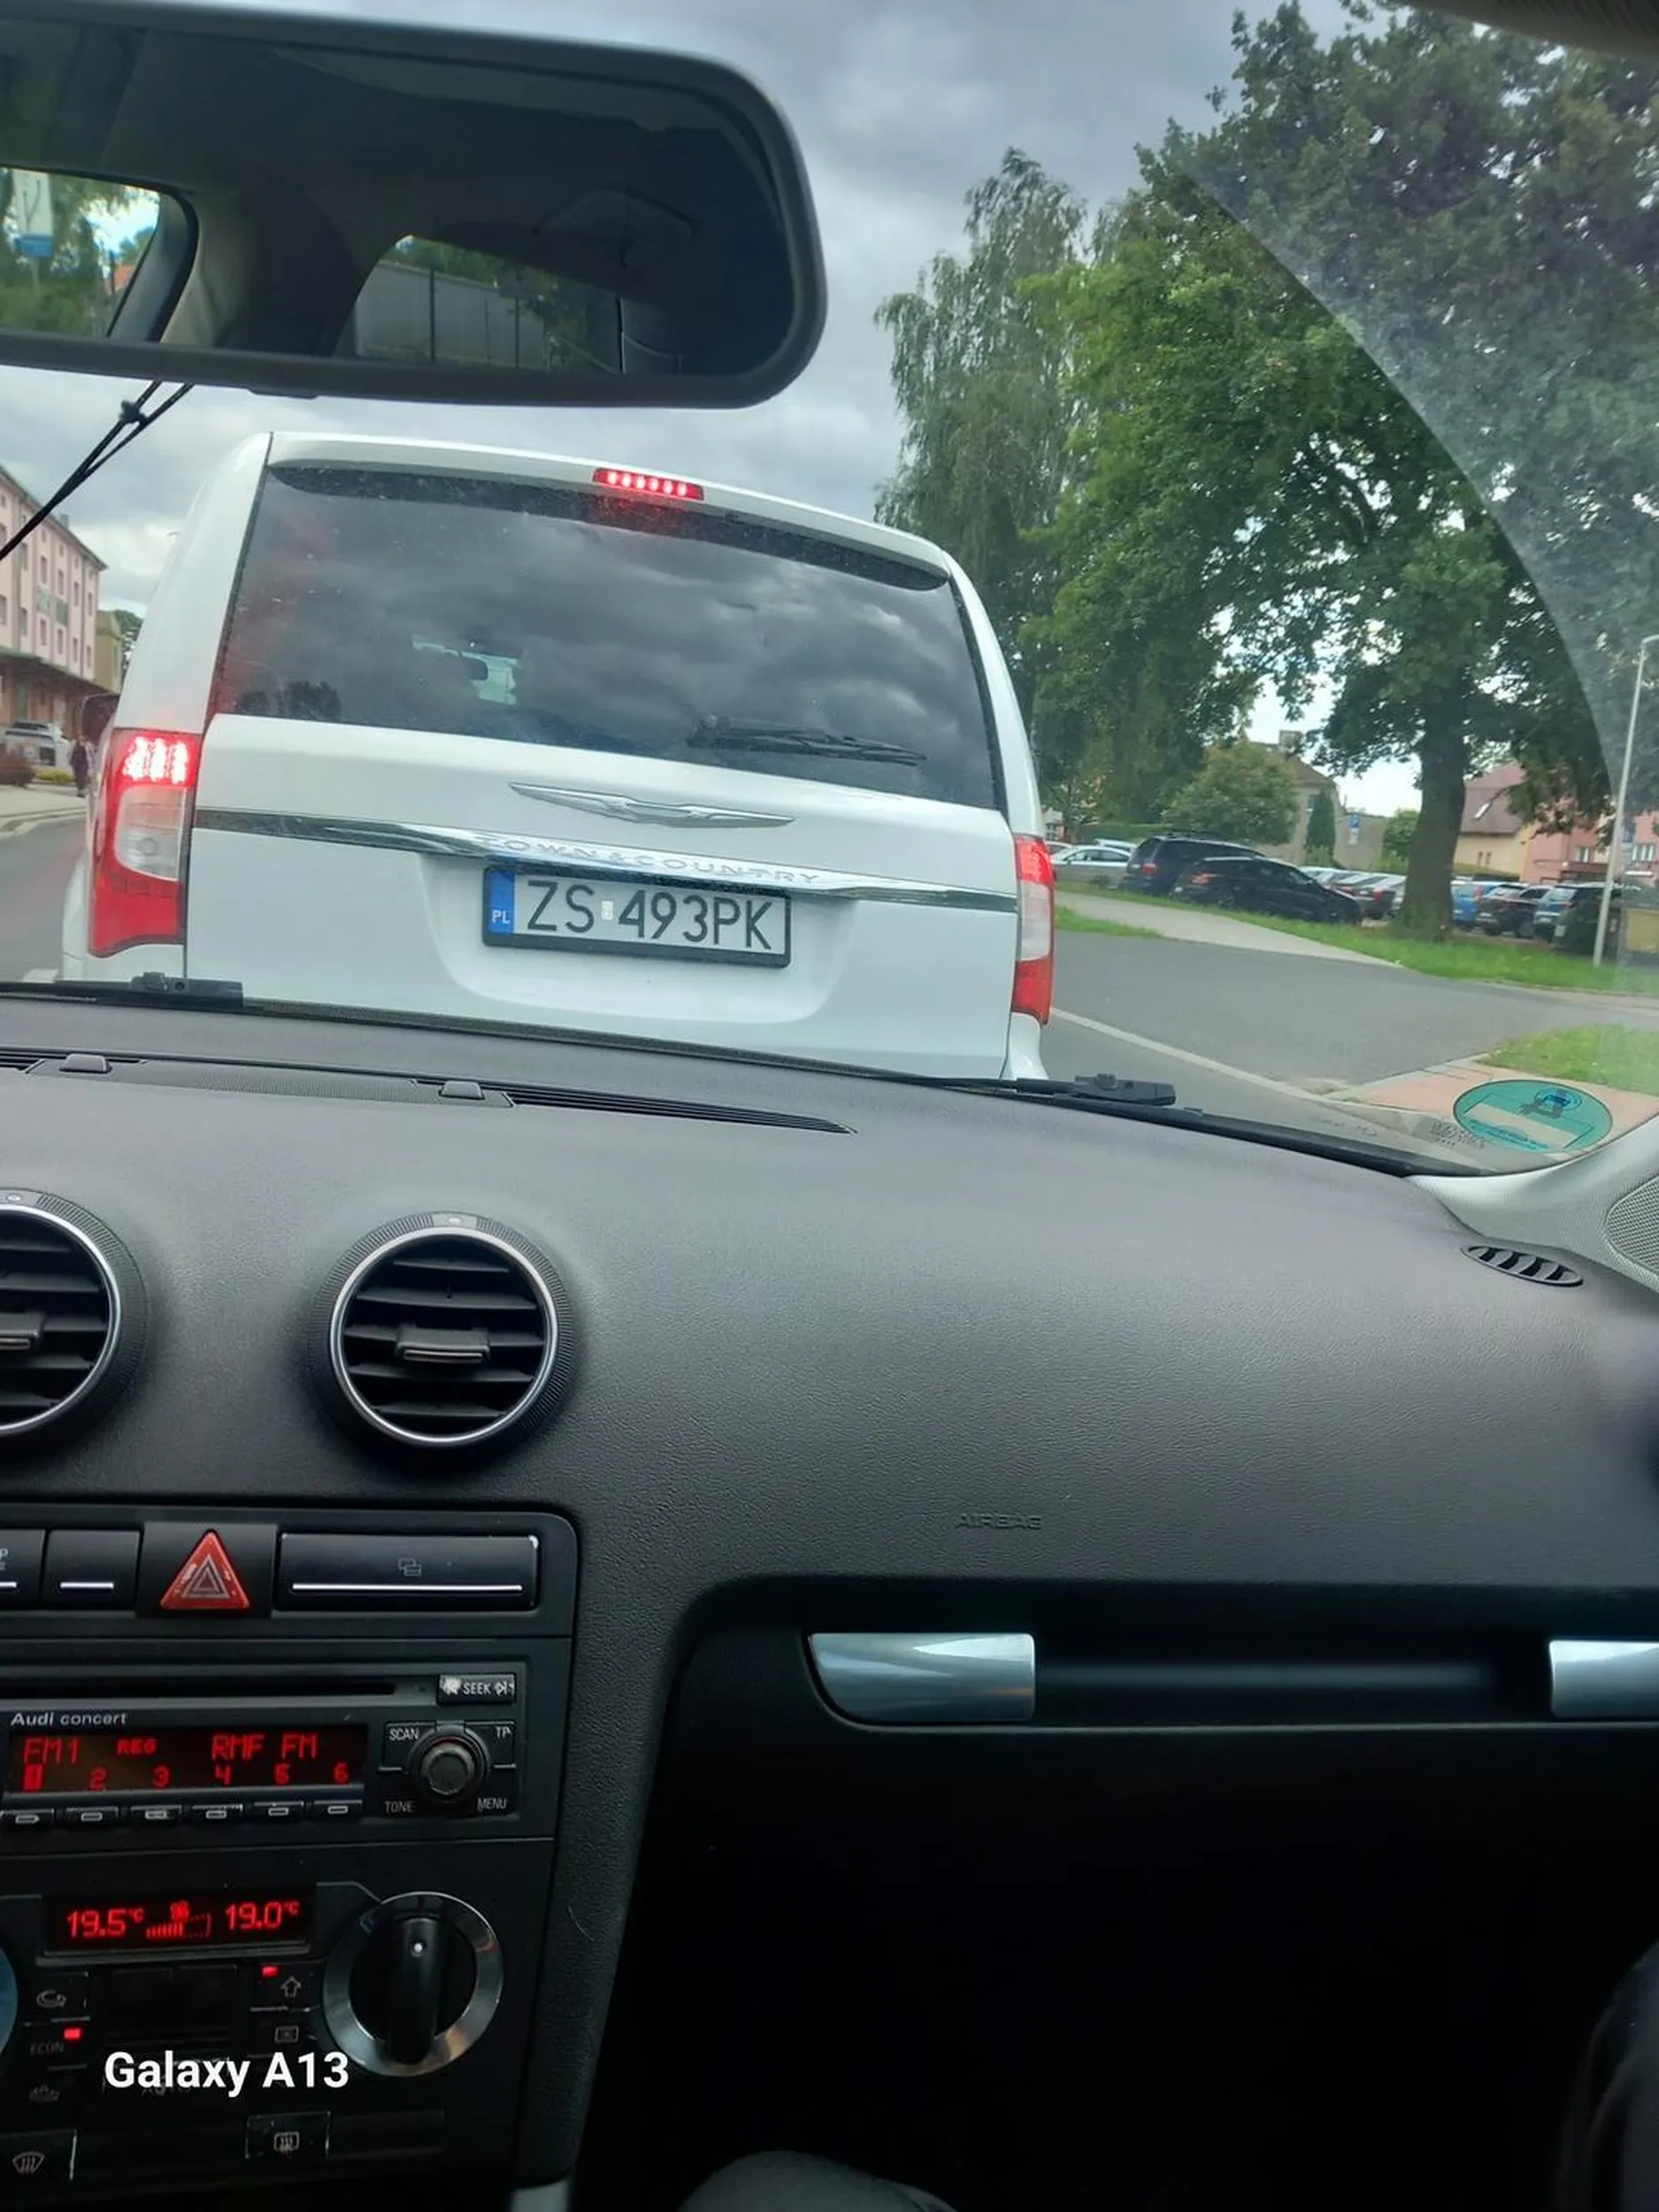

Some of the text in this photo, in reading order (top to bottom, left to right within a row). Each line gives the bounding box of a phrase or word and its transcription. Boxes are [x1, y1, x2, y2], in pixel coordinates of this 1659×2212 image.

[492, 910, 511, 926] PL
[526, 879, 772, 950] ZS 493PK
[956, 1513, 1042, 1531] AIRBAG
[463, 1682, 492, 1695] SEEK
[11, 1711, 127, 1726] Audi concert
[388, 1727, 420, 1741] SCAN
[495, 1725, 512, 1740] TP
[23, 1735, 81, 1765] FM1
[211, 1731, 319, 1762] RMF FM
[89, 1766, 108, 1792] 2
[152, 1765, 170, 1789] 3
[214, 1764, 232, 1786] 4
[273, 1763, 291, 1786] 5
[333, 1762, 349, 1786] 6
[385, 1800, 414, 1814] TONE
[477, 1797, 508, 1812] MENU
[29, 2041, 65, 2057] ECON
